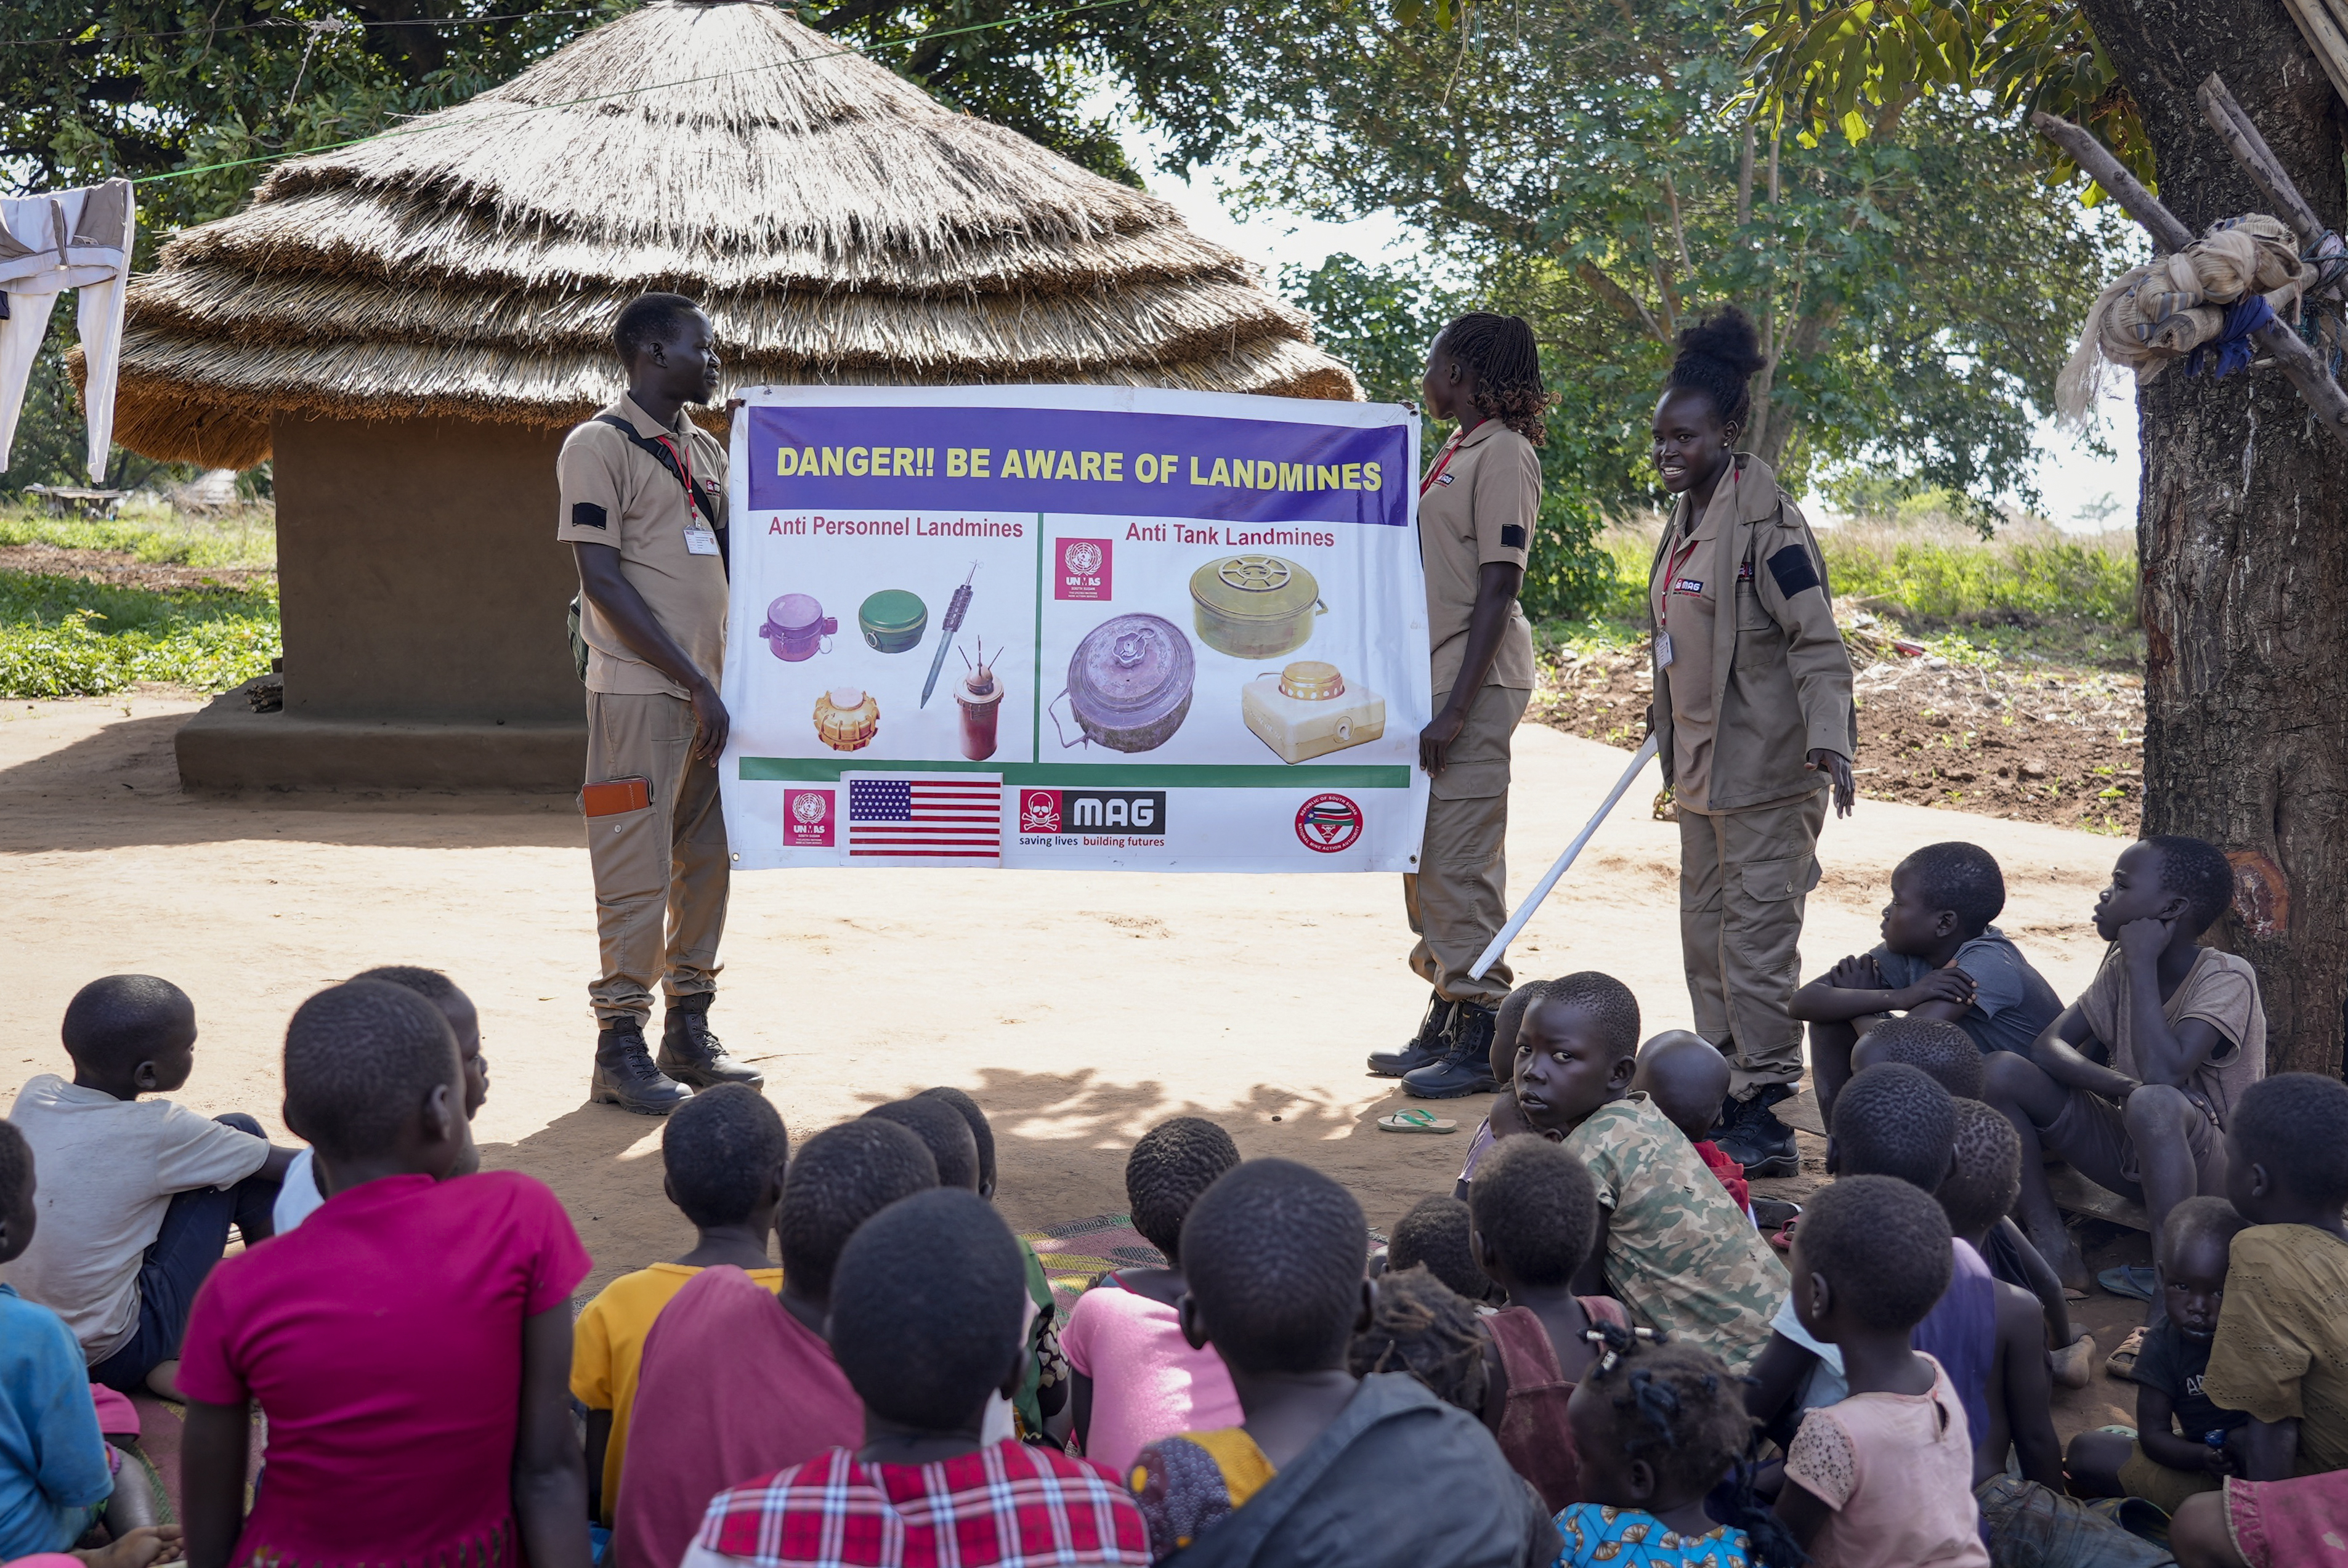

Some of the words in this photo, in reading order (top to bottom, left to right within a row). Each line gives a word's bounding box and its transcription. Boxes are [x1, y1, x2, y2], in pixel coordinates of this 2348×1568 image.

[777, 447, 934, 477] DANGER!!
[946, 448, 990, 478] BE
[1001, 449, 1123, 481] AWARE
[1135, 453, 1178, 483] OF
[1190, 456, 1382, 491] LANDMINES
[769, 516, 806, 535] Anti
[813, 516, 910, 536] Personnel
[917, 518, 1023, 538] Landmines
[1126, 523, 1167, 542] Anti
[1173, 523, 1219, 545] Tank
[1226, 528, 1335, 547] Landmines
[1066, 576, 1101, 586] UNMAS
[1682, 581, 1701, 591] MAG
[1074, 798, 1154, 826] MAG
[1300, 798, 1319, 817] REPUBLIC
[1329, 796, 1346, 804] SOUTH
[1345, 801, 1358, 815] SUDAN
[793, 825, 825, 834] UNMAS
[1342, 825, 1360, 847] AUTHORITY
[1019, 836, 1052, 847] saving
[1055, 836, 1078, 846] lives
[1083, 836, 1125, 848] building
[1128, 836, 1165, 846] futures
